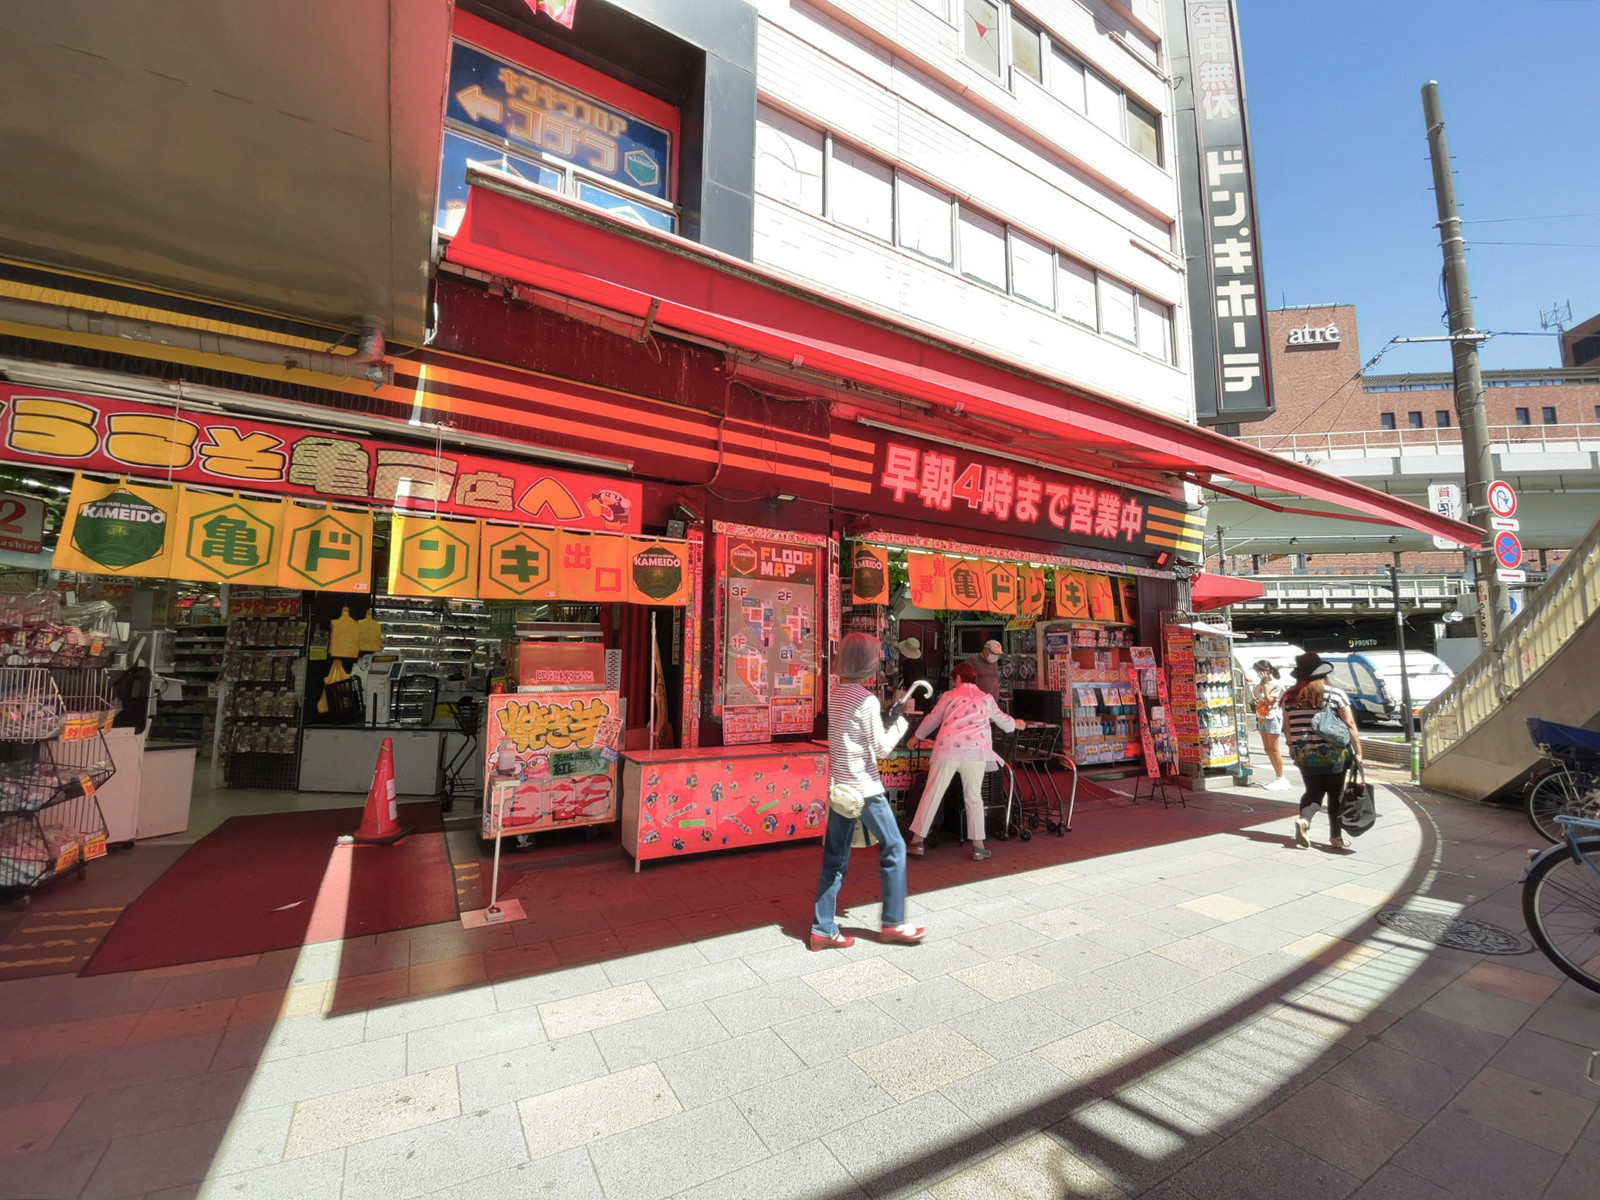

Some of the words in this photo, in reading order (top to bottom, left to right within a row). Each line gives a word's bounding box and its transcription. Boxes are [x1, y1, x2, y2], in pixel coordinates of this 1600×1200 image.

[1193, 5, 1238, 120] 年中無休
[508, 98, 618, 174] コチラ
[1288, 322, 1340, 345] atré
[881, 441, 1145, 543] 早朝4時まで営業中
[81, 505, 165, 524] KAMEIDO
[0, 541, 41, 551] ashier
[634, 556, 681, 567] KAMEIDO
[760, 547, 813, 566] FLOOR
[564, 543, 621, 592] 出口
[761, 561, 796, 577] MAP
[852, 559, 882, 570] AMEIDO
[731, 587, 748, 597] 3F
[778, 591, 792, 601] 2F
[732, 637, 746, 648] 1F
[1354, 639, 1378, 647] PRONTO
[1177, 684, 1195, 693] 398
[1178, 714, 1198, 723] 398
[67, 727, 79, 738] 99
[87, 842, 105, 855] 128
